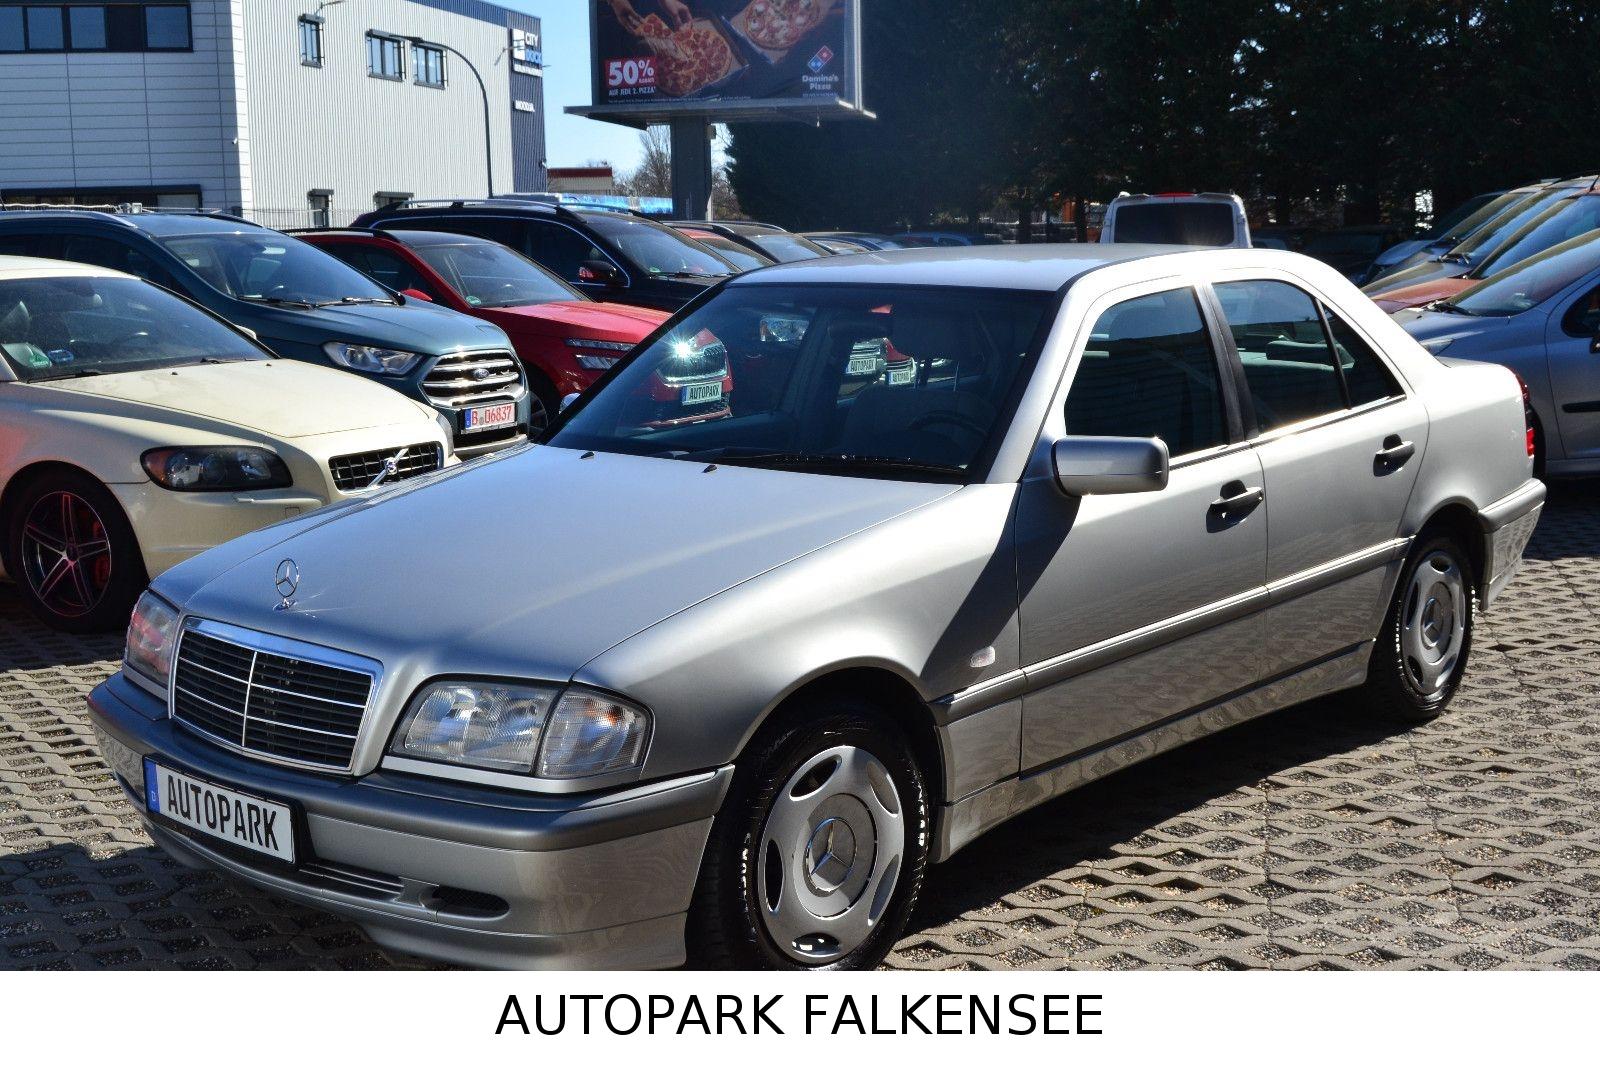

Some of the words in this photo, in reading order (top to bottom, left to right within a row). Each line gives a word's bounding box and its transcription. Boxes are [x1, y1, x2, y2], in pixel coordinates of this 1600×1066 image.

[608, 60, 655, 86] 50%
[689, 385, 720, 400] AUTOPARK
[167, 774, 279, 852] AUTOPARK
